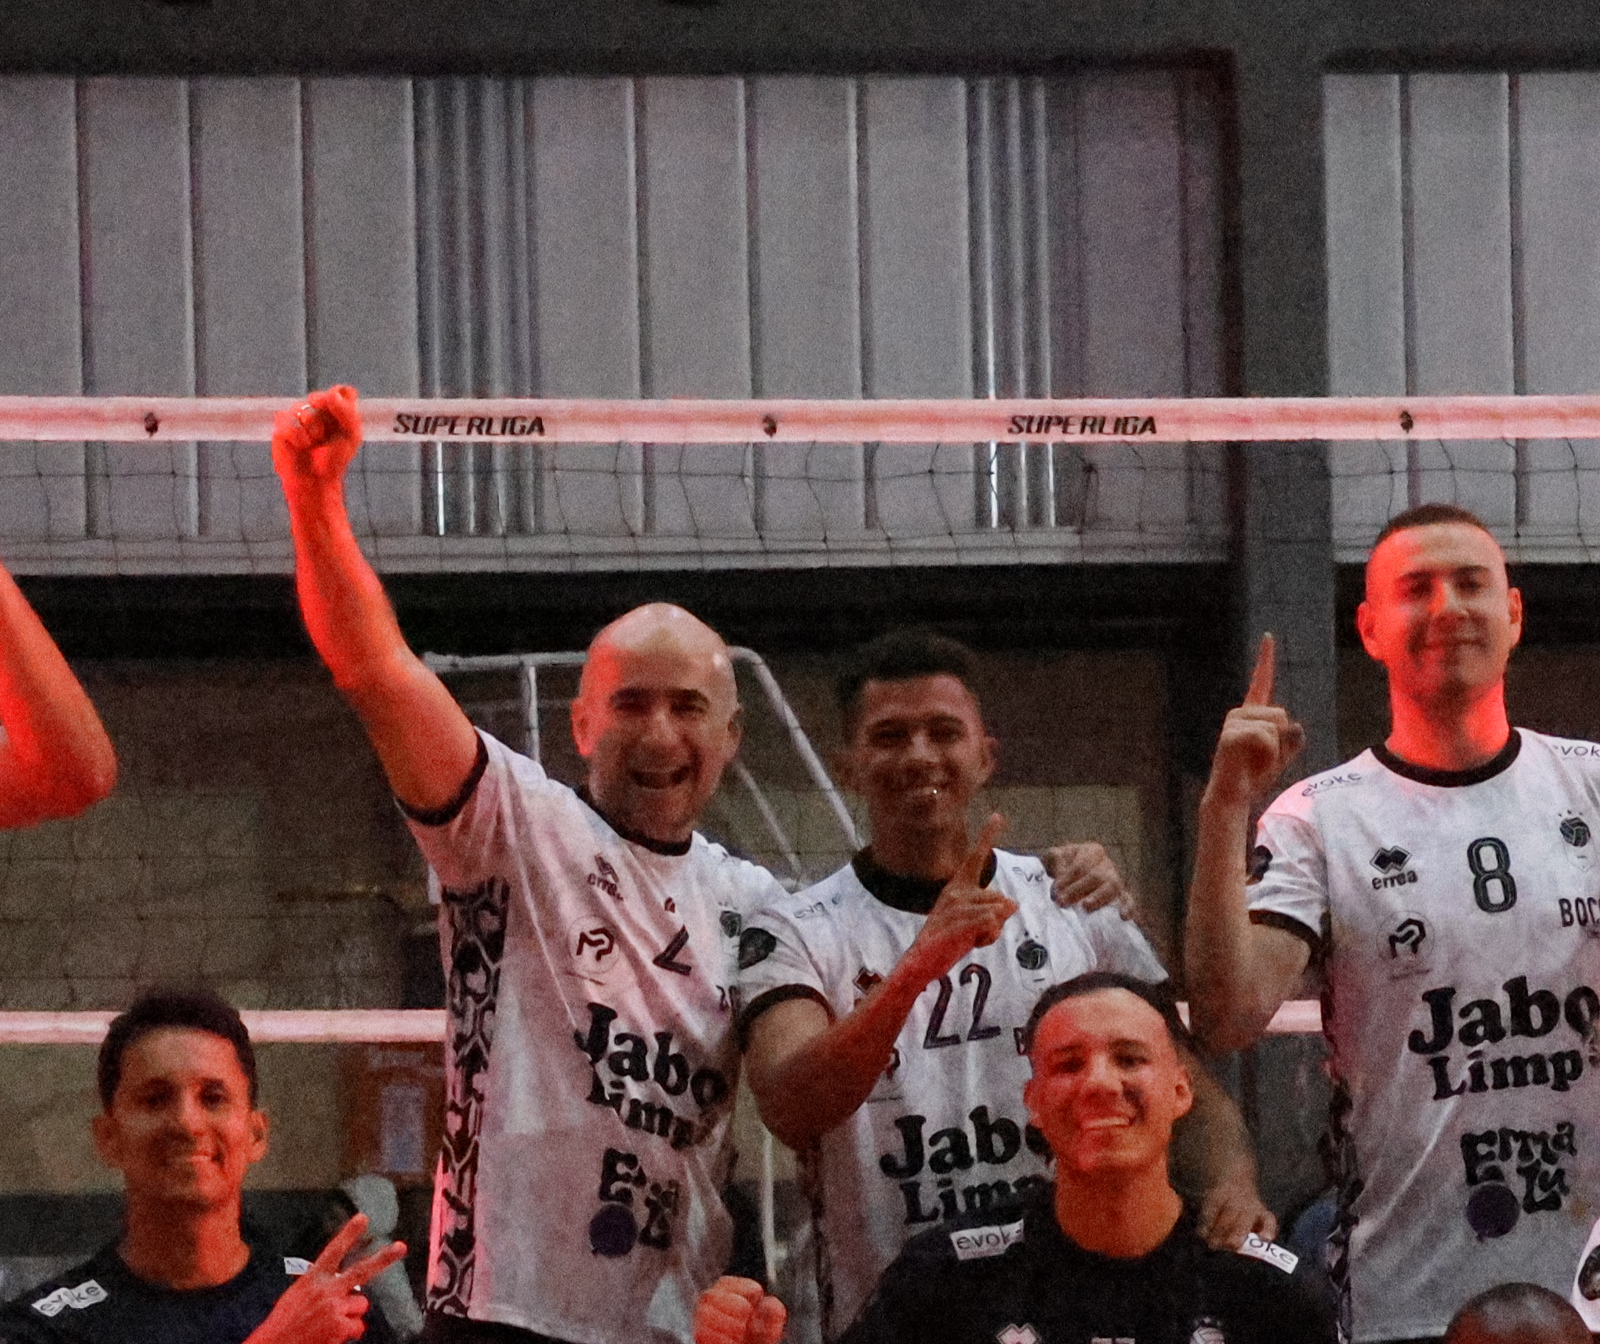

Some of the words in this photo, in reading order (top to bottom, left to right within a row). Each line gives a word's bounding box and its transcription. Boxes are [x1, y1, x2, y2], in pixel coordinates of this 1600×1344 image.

[394, 412, 546, 438] SUPERLIGA
[1008, 413, 1158, 437] SUPERLIGA
[1466, 837, 1518, 913] 8
[924, 963, 1000, 1049] 22
[1408, 976, 1600, 1055] Jabo
[573, 1001, 727, 1112] Jabo
[1427, 1048, 1584, 1101] Limp
[1247, 1235, 1297, 1269] oke
[38, 1283, 102, 1315] evke
